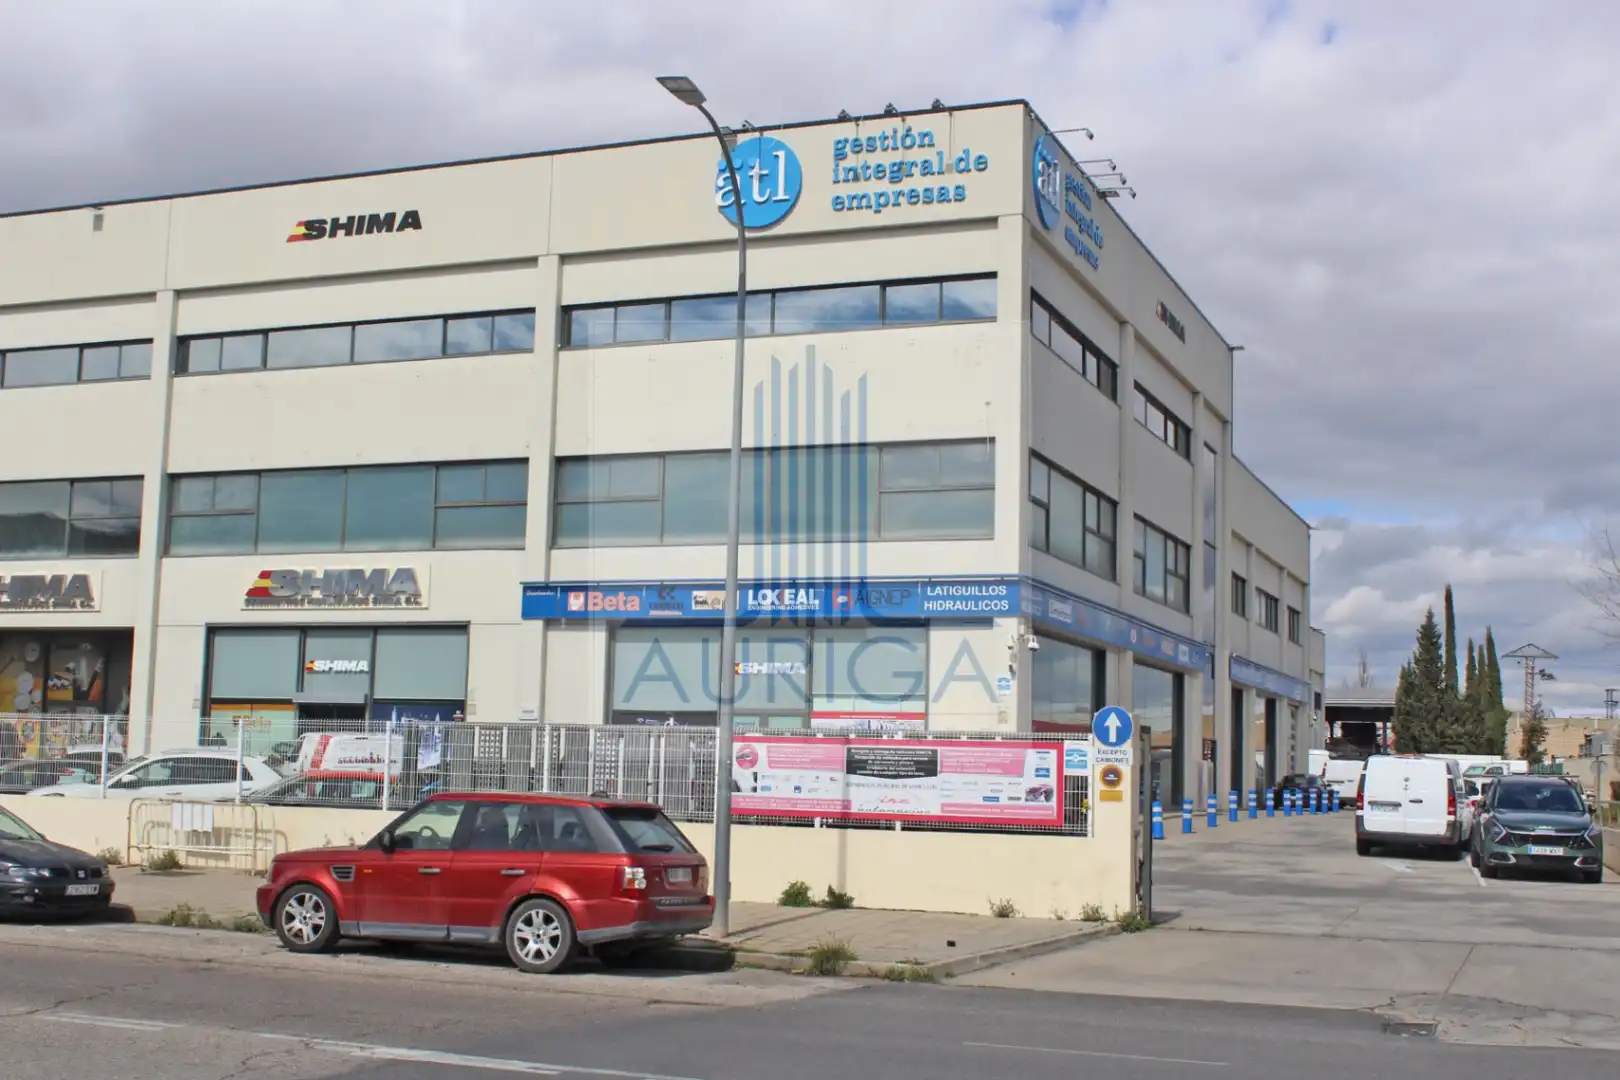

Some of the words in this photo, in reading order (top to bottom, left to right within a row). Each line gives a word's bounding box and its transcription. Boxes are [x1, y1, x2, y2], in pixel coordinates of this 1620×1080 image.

[833, 125, 935, 160] gestión
[833, 150, 945, 184] integral
[954, 148, 988, 173] de
[831, 183, 966, 213] empresas
[301, 209, 423, 240] SHIMA
[267, 568, 422, 597] SHIMA
[926, 585, 1007, 596] LATIGUILLOS
[587, 591, 640, 612] Beta
[924, 600, 1009, 611] HIDRAULICOS
[314, 659, 369, 673] SHIMA
[738, 661, 806, 675] SHIMA
